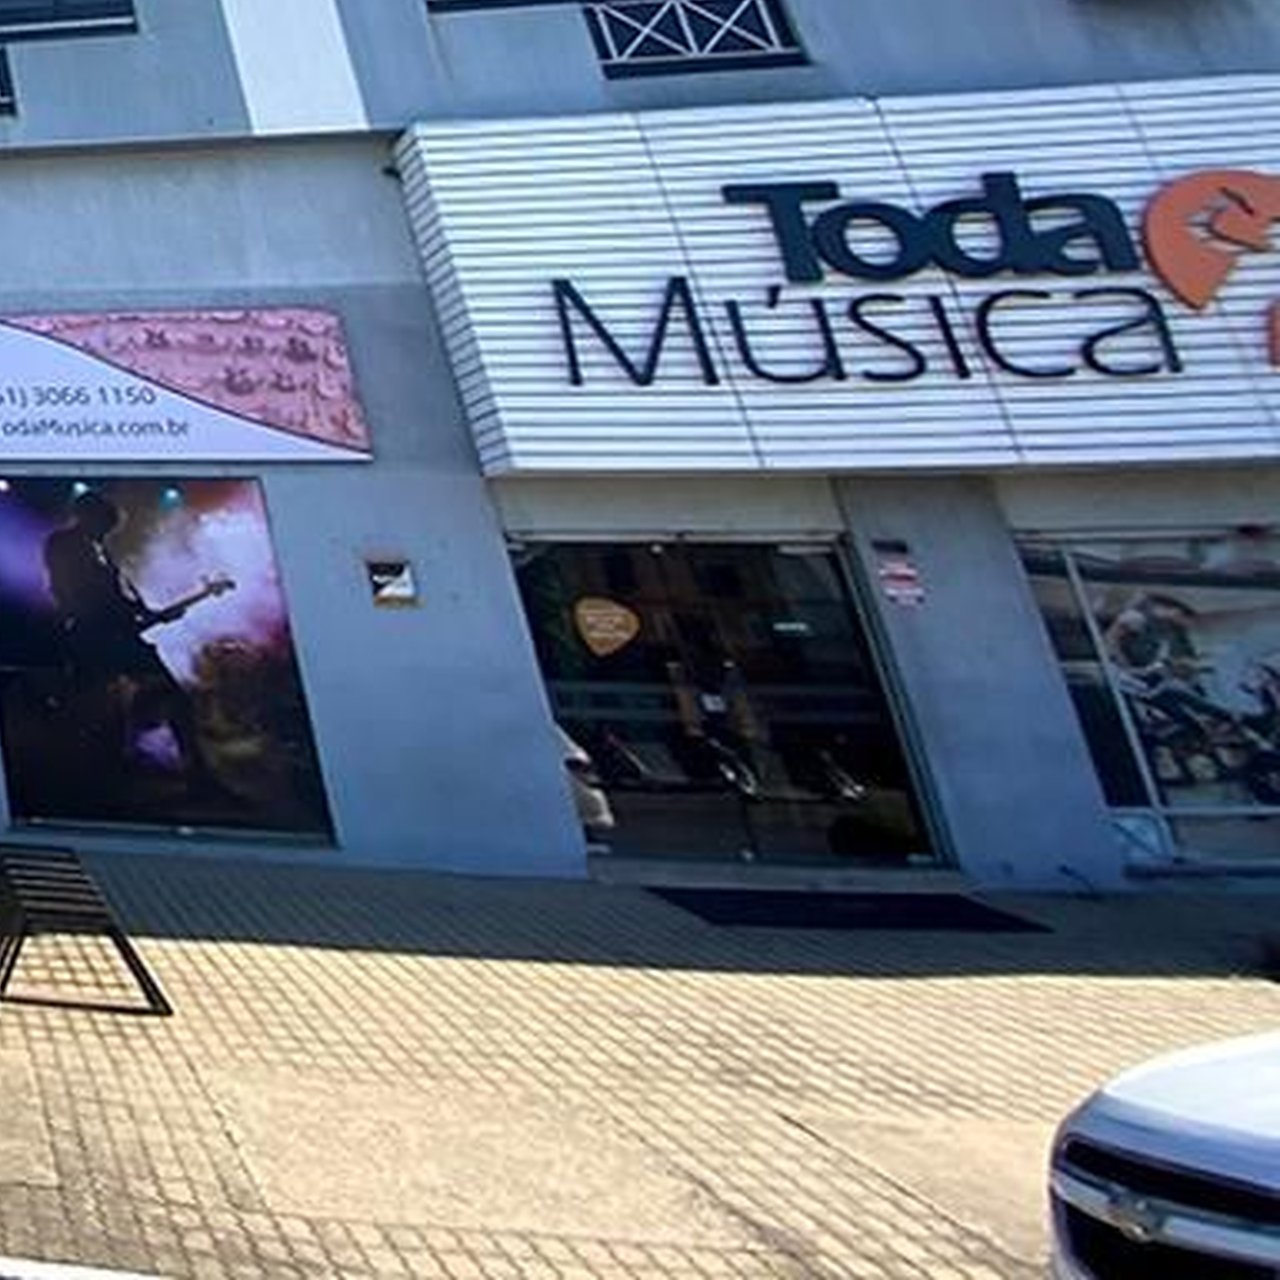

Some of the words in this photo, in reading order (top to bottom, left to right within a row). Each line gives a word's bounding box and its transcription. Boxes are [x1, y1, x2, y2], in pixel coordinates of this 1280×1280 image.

[721, 172, 1142, 284] Toda
[550, 276, 1183, 387] Música
[34, 386, 91, 405] 3066
[97, 386, 156, 405] 1150
